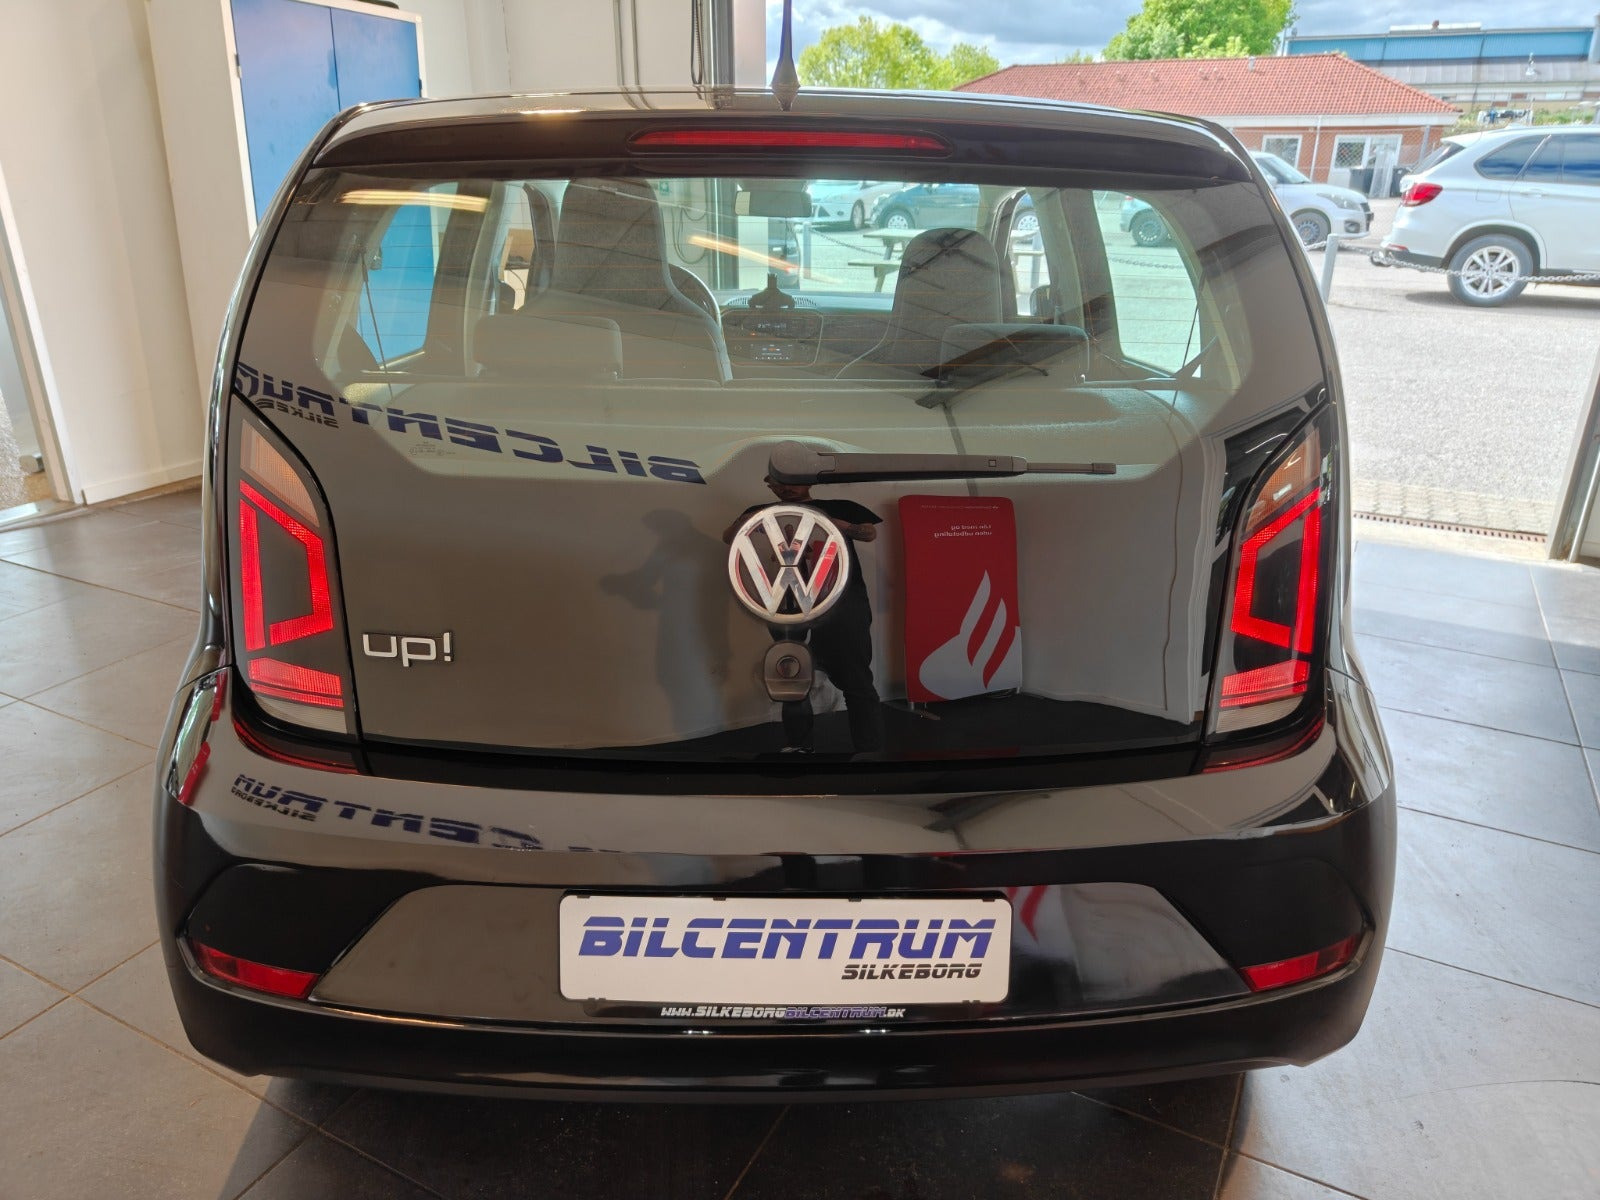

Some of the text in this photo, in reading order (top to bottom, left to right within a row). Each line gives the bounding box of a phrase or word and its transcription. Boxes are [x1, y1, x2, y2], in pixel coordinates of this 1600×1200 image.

[362, 632, 453, 667] up!
[578, 916, 996, 959] BILCENTRUM
[841, 963, 982, 980] SILKEBORG
